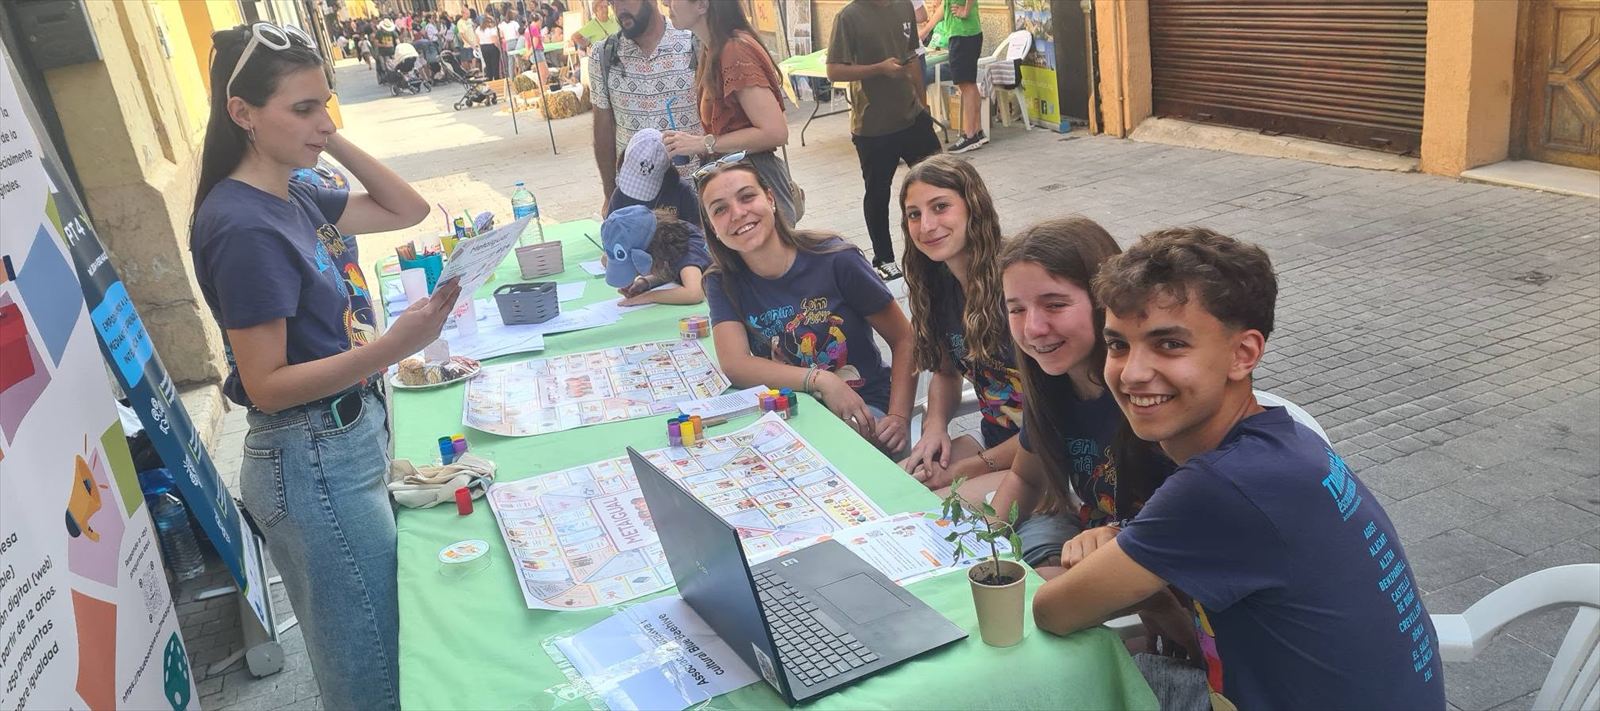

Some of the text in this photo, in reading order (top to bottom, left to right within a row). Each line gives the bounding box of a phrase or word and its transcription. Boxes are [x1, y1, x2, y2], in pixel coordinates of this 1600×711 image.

[0, 532, 18, 555] esa
[603, 497, 643, 544] METAIGUAL
[1369, 532, 1388, 557] ALACANT
[8, 578, 31, 612] digital
[1, 632, 16, 666] partir
[16, 619, 26, 635] de
[26, 609, 35, 622] 12
[17, 620, 53, 675] preguntas
[658, 613, 725, 676] cultural Blue Beehive
[27, 641, 59, 689] igualdad
